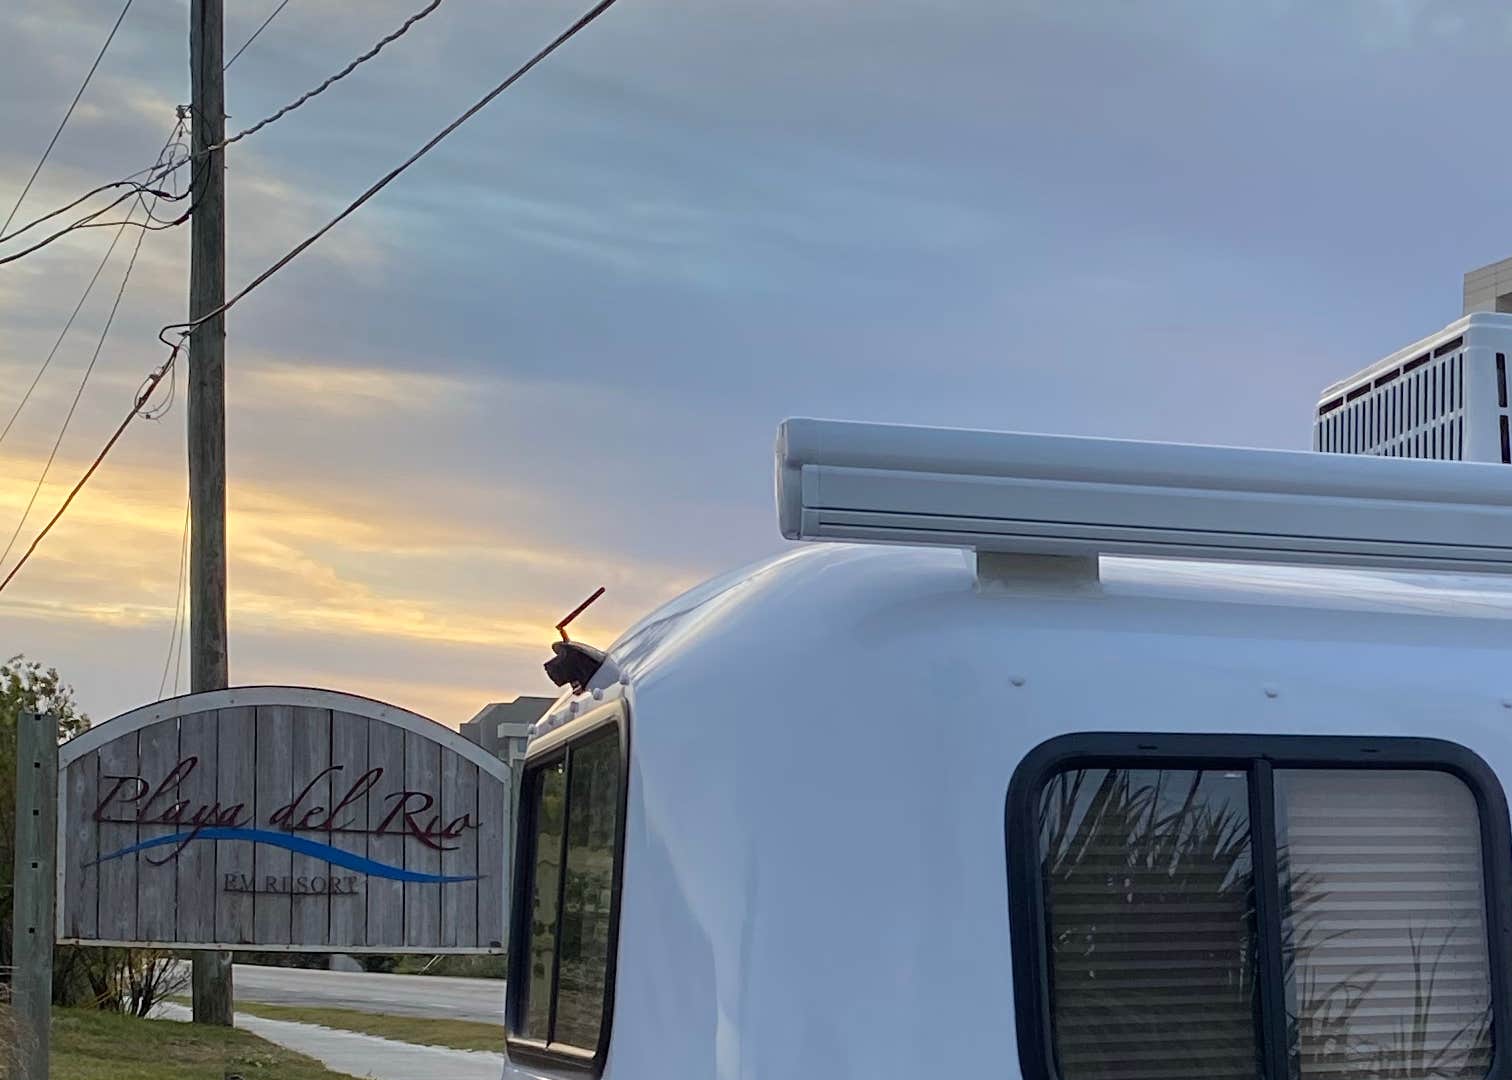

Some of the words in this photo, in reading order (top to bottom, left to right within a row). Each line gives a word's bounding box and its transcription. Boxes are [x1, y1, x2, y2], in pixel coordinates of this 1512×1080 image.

[93, 757, 252, 866] Playa
[269, 765, 384, 832] del
[376, 791, 484, 852] Rio
